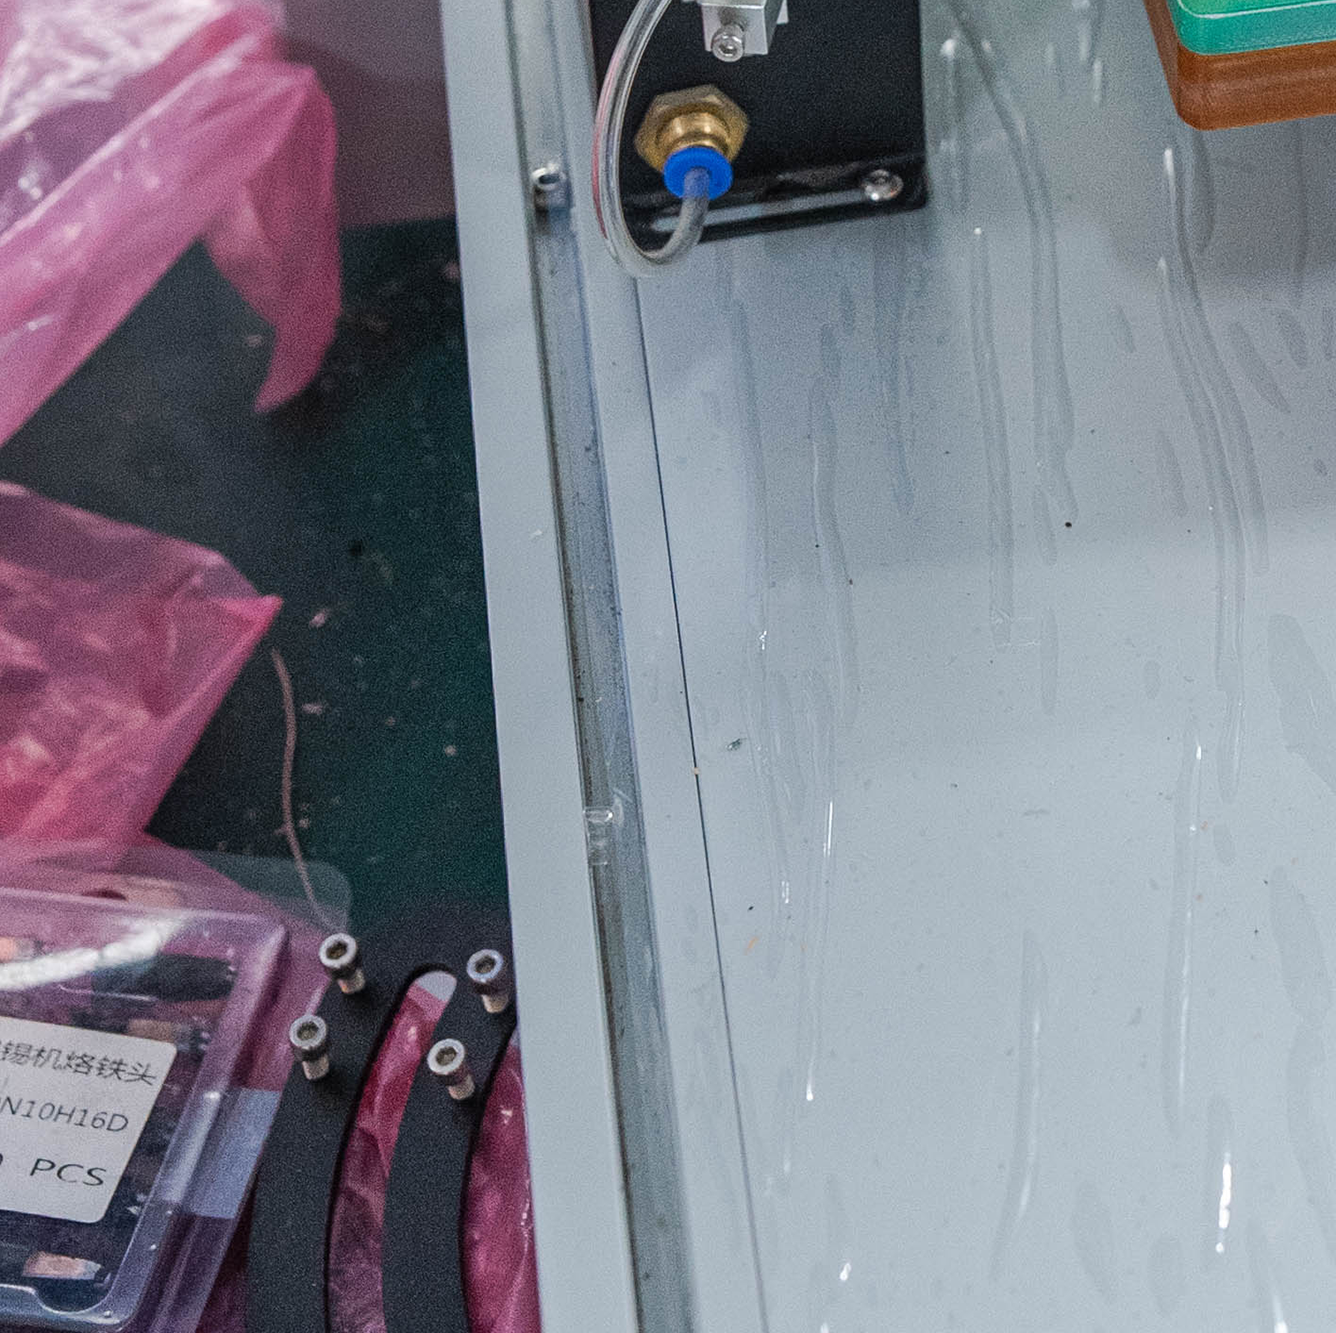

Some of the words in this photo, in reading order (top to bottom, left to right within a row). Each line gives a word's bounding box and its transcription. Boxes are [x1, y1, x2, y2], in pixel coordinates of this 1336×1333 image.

[0, 1040, 157, 1086] 锡机烙铁头
[0, 1095, 129, 1133] N10H16D
[30, 1157, 107, 1187] PCS
